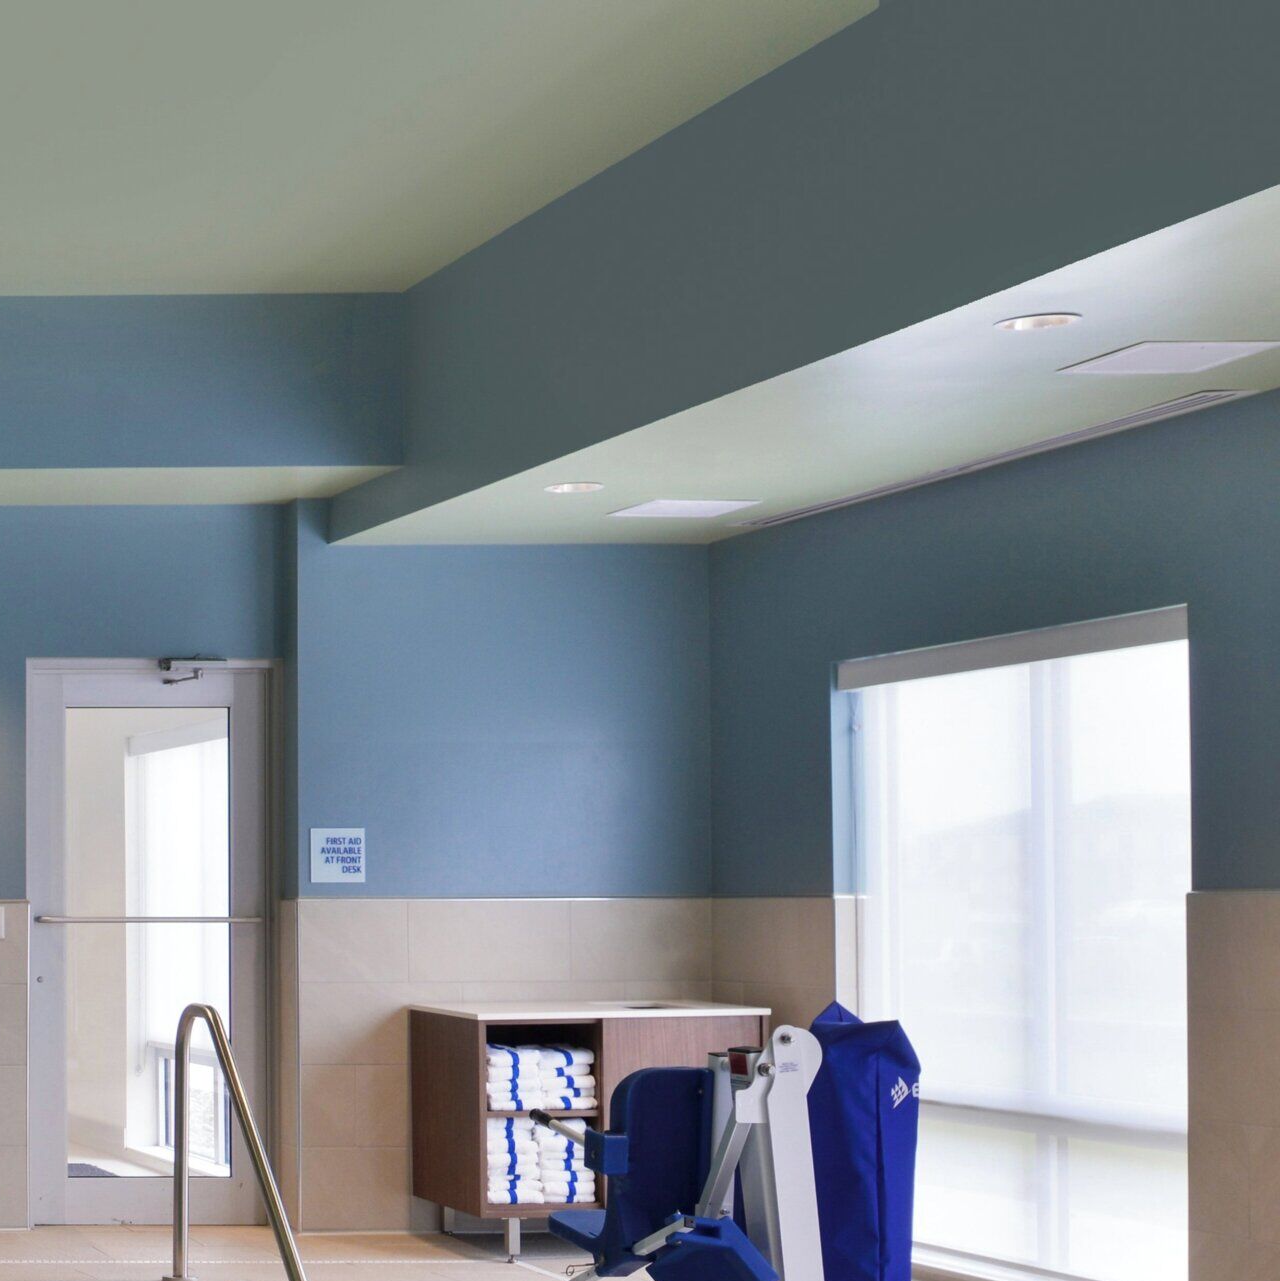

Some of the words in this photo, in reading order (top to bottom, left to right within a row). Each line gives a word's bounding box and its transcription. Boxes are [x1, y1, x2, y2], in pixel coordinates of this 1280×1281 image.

[326, 837, 346, 845] FIRST
[348, 837, 362, 845] AID
[325, 856, 335, 864] AT
[336, 856, 361, 864] FRONT
